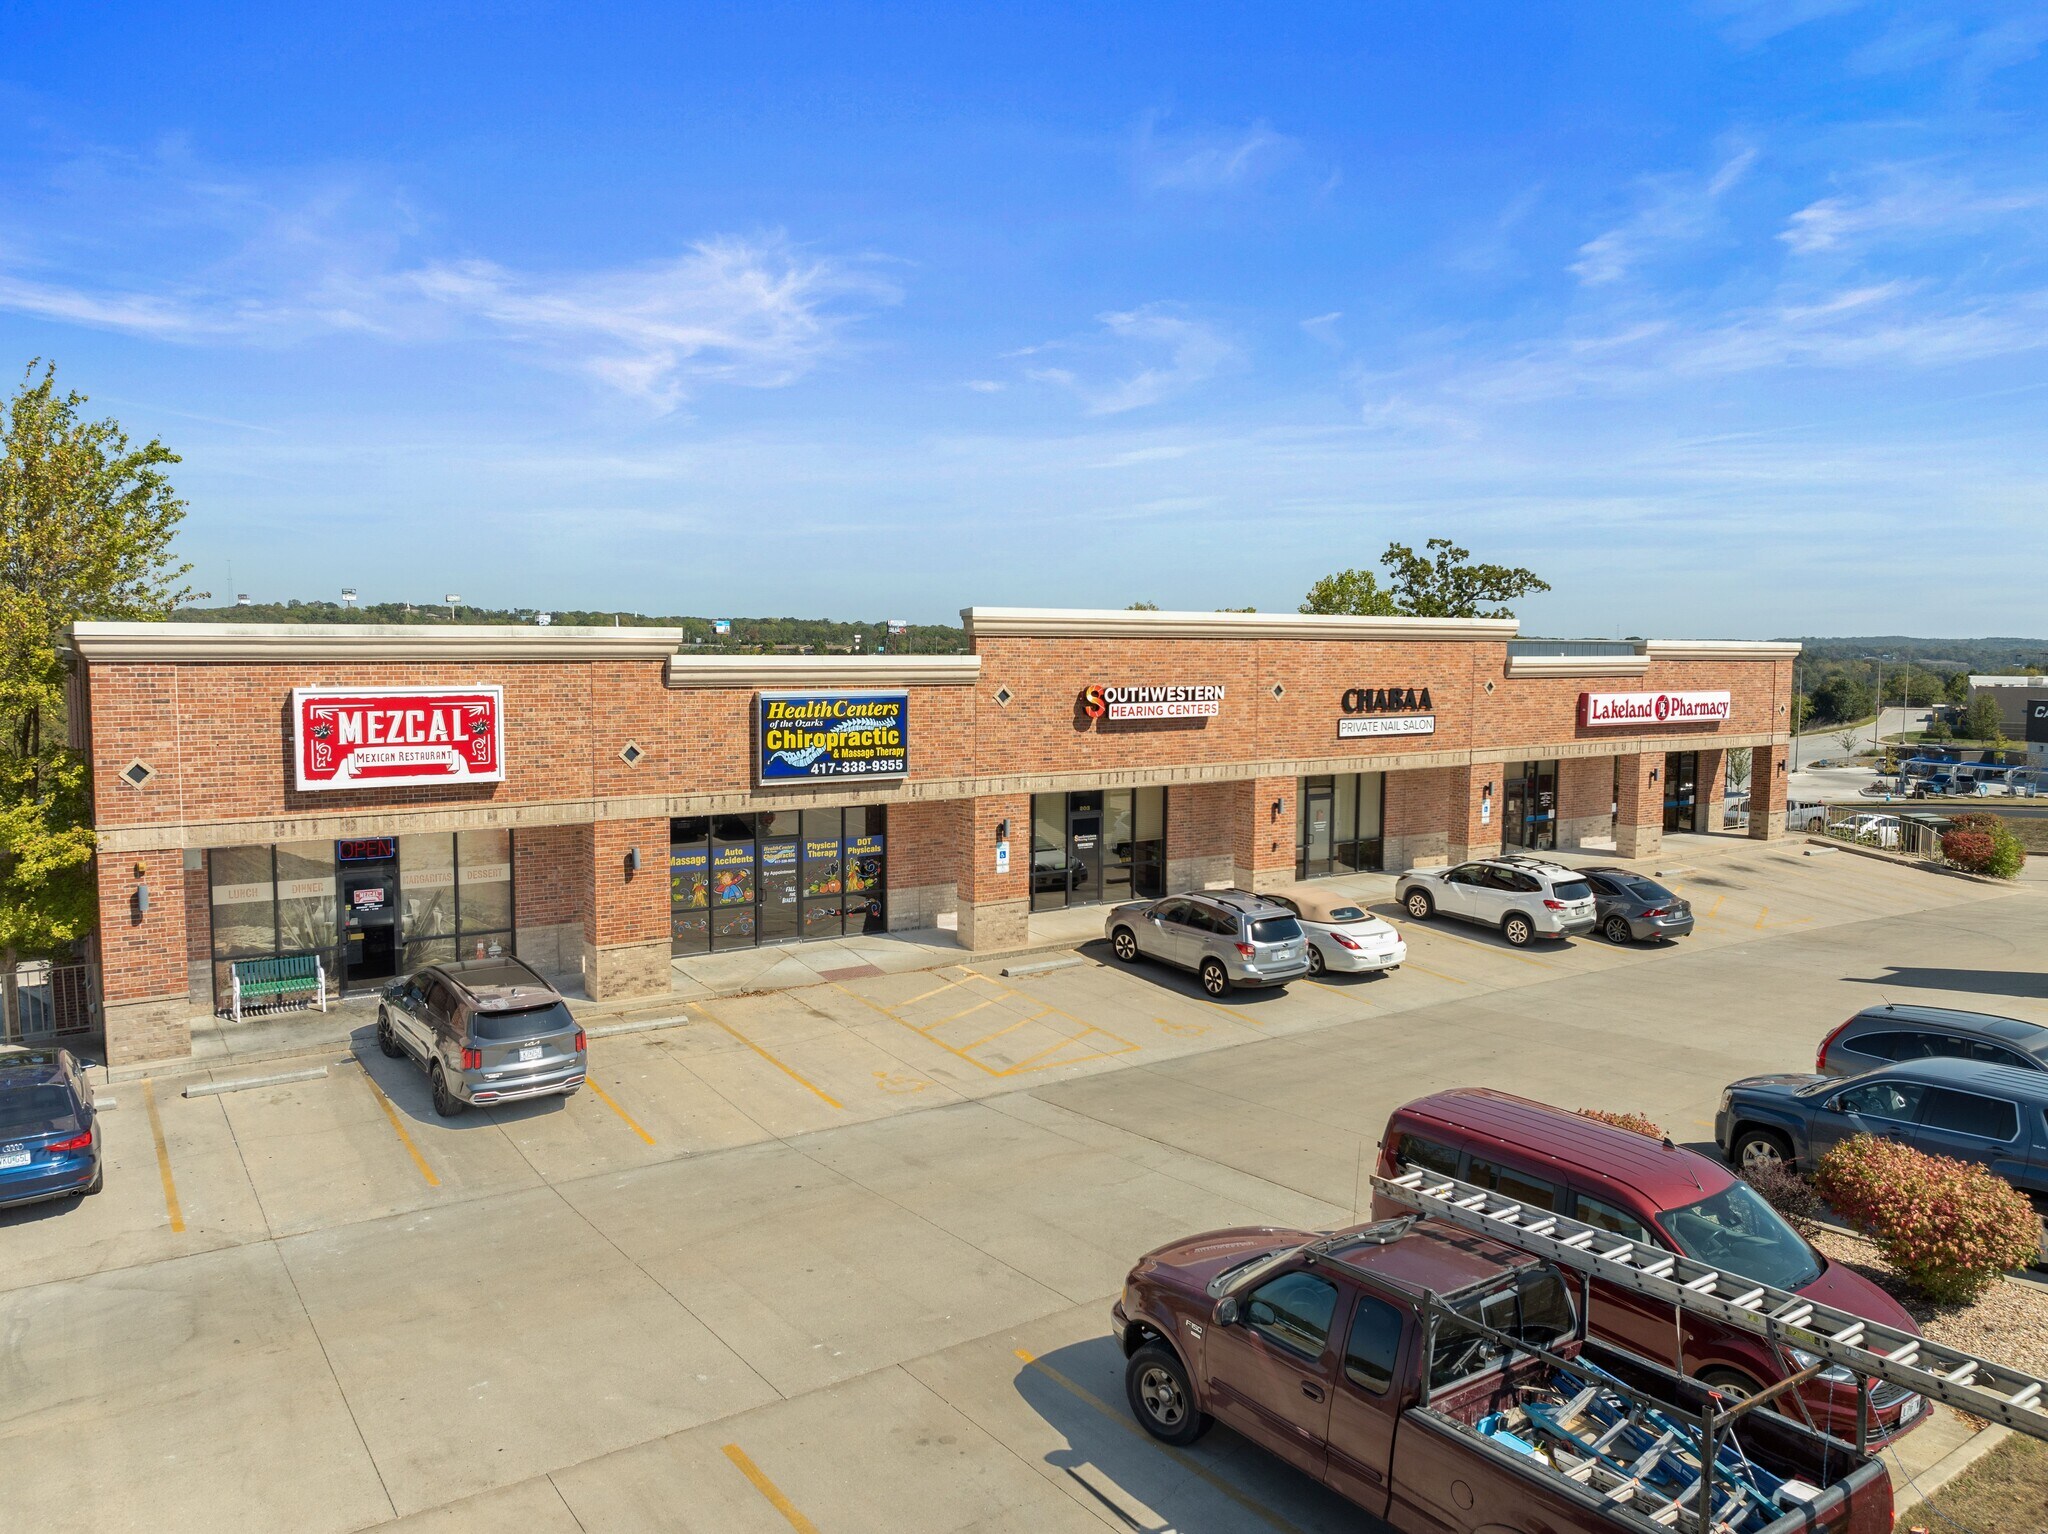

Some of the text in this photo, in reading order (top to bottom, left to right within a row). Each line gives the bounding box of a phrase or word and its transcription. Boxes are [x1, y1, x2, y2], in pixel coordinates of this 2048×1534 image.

[1085, 684, 1225, 718] SOUTHWESTERN
[1341, 688, 1433, 714] CHABAA
[1111, 703, 1217, 717] HEARING CENTERS
[1592, 698, 1652, 720] Lakeland
[1671, 697, 1729, 719] Pharmacy
[337, 709, 469, 746] MEZCAL
[769, 719, 824, 729] of the Ozarks
[1341, 719, 1433, 733] PRIVATE NAIL SALON
[767, 727, 899, 751] Chiropractic
[356, 750, 453, 763] MEXICAN RESTAURANT
[833, 747, 905, 759] & Massage Therapy
[811, 759, 904, 775] 417-338-9355
[807, 841, 838, 851] Physical
[857, 837, 872, 846] DOT
[341, 840, 391, 858] OPEN
[724, 847, 743, 857] Auto
[808, 849, 838, 859] Therapy
[848, 845, 882, 855] Physicals
[670, 855, 707, 867] Massage
[714, 856, 753, 866] Accidents
[402, 872, 453, 885] MARGARITAS
[467, 867, 503, 880] DESSERT
[228, 887, 258, 899] LUNCH
[291, 882, 324, 894] DINNER
